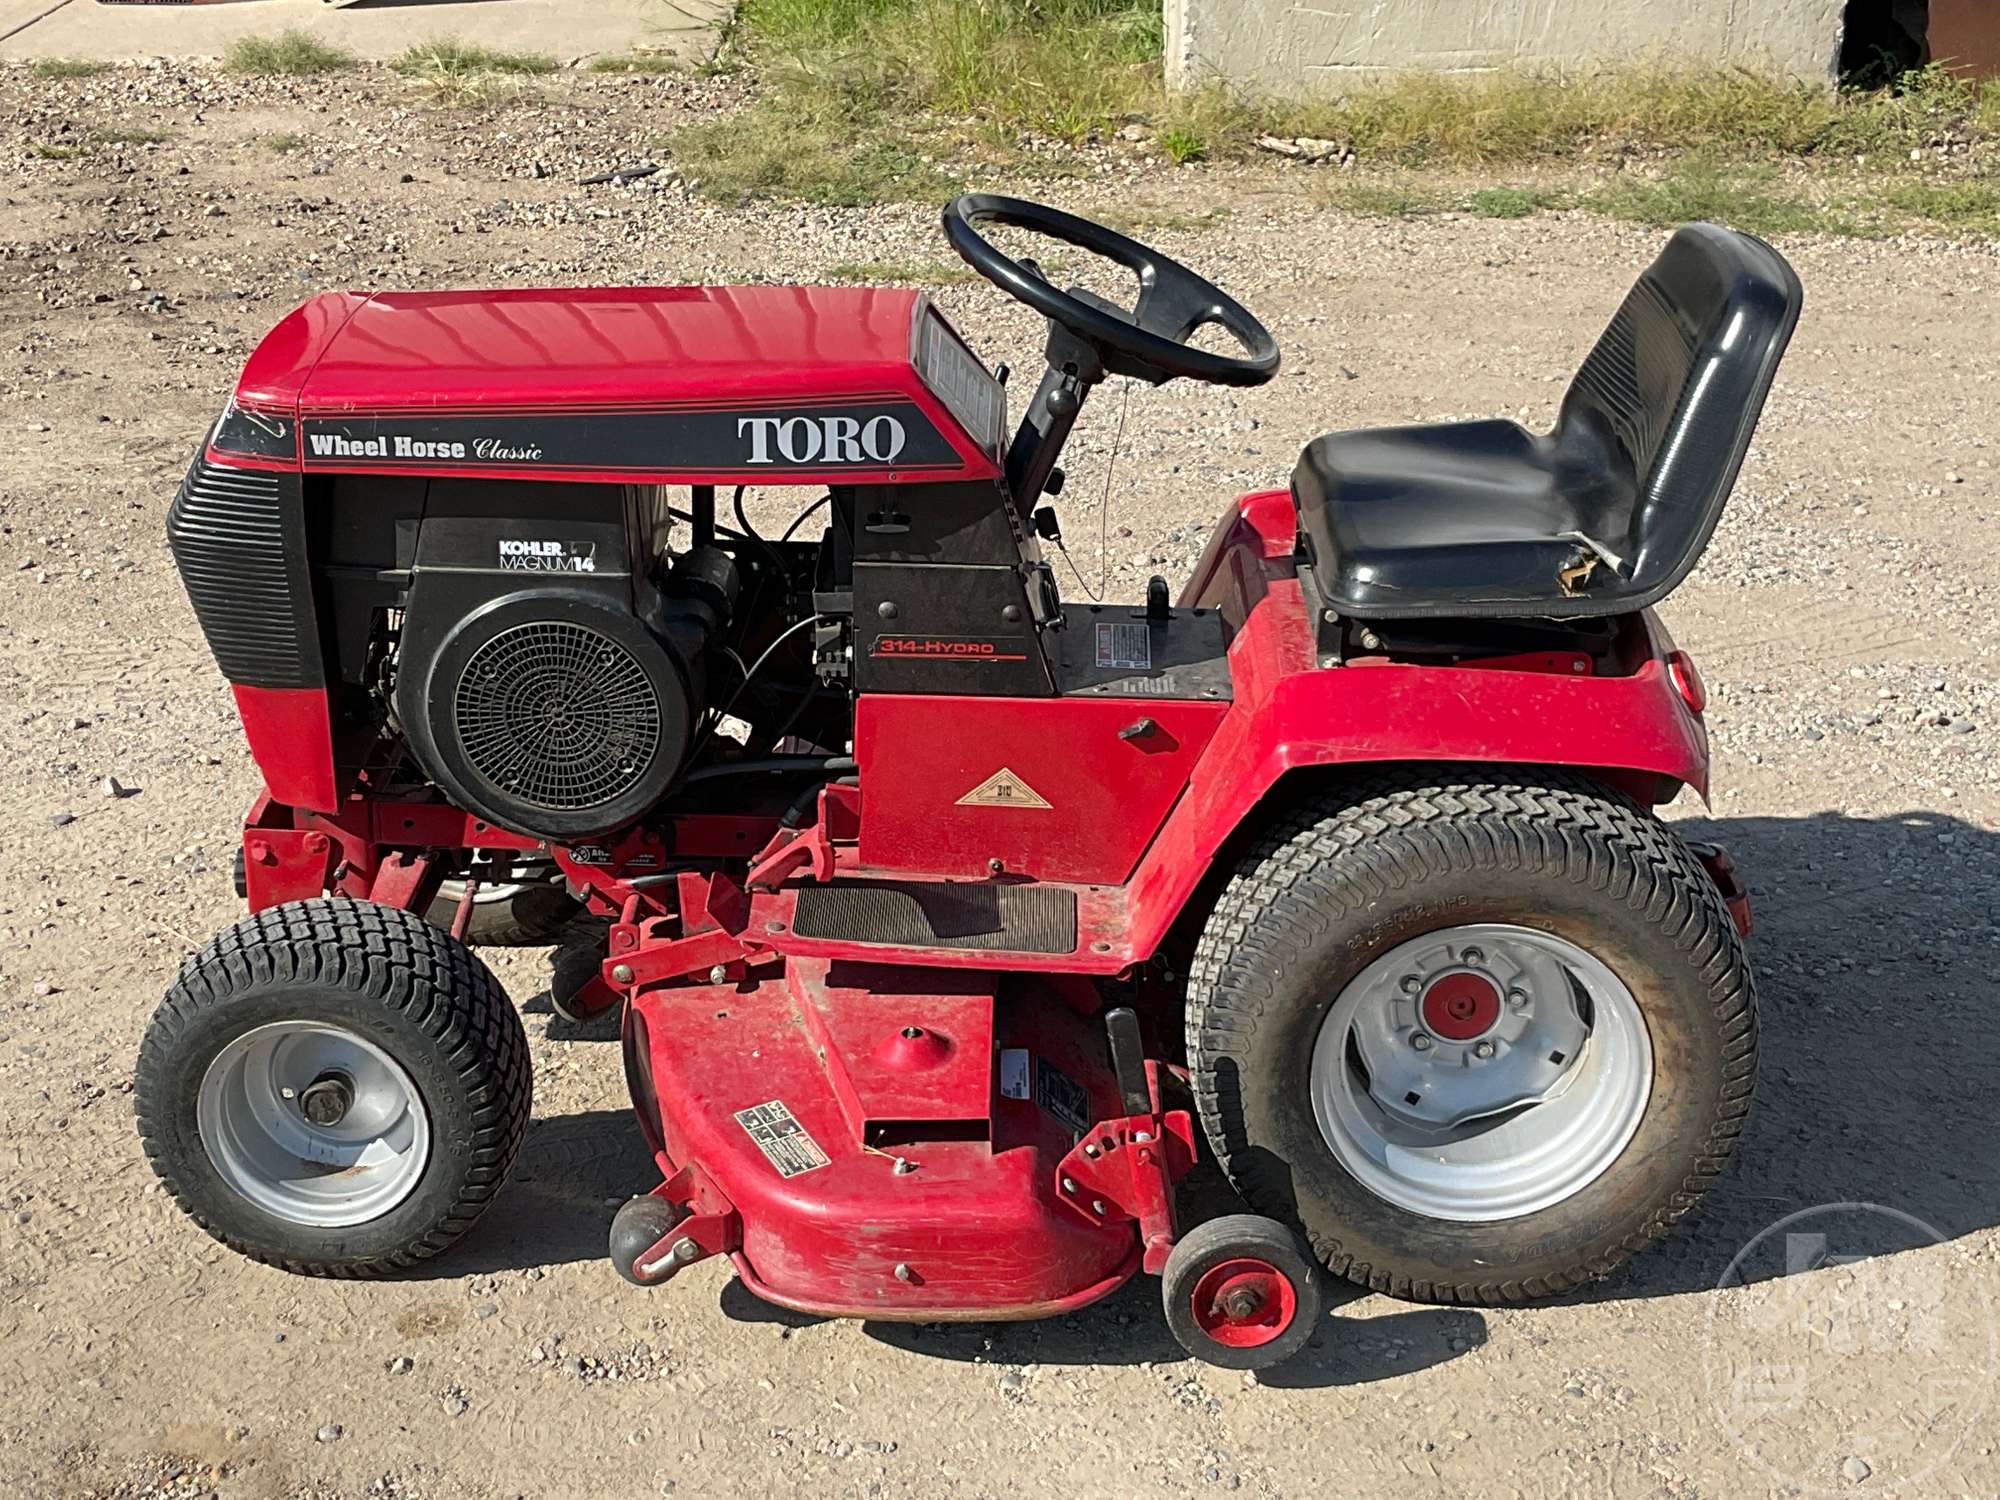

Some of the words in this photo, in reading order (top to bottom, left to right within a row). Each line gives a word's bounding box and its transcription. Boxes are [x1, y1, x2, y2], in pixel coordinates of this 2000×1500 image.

[310, 434, 387, 457] Wheel
[394, 436, 465, 459] Horse
[472, 438, 545, 461] Classic
[737, 415, 905, 463] TORO
[499, 540, 563, 556] KOHLER
[880, 640, 994, 653] 314-HYDRO
